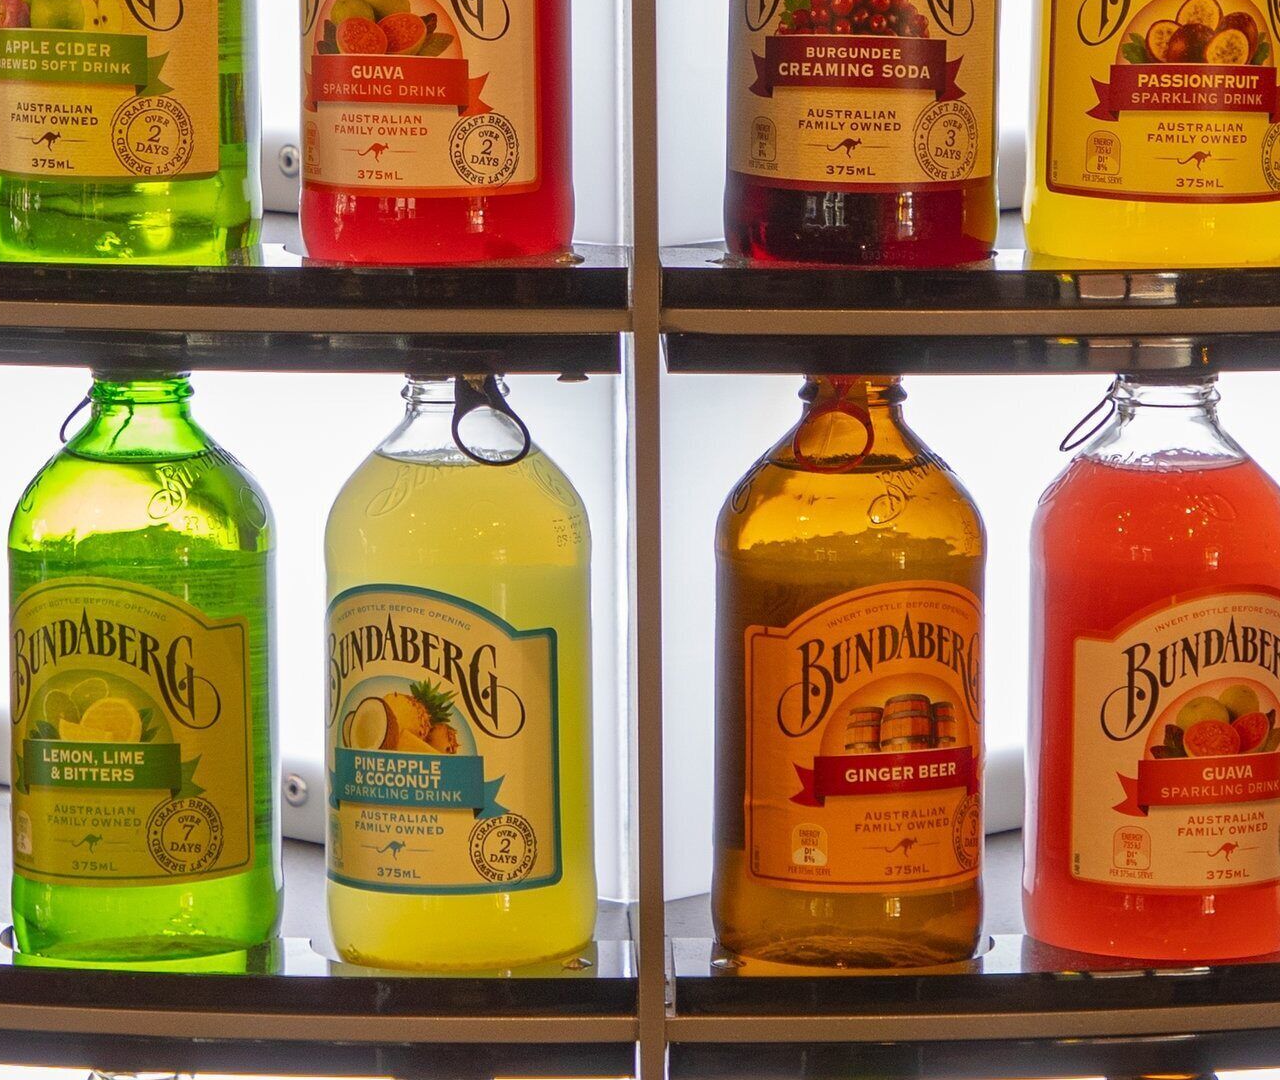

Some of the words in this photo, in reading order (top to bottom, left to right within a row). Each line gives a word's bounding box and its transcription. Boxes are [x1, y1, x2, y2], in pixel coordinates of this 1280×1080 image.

[5, 40, 50, 54] APPLE
[55, 41, 111, 57] CIDER
[806, 47, 901, 59] BURGUNDEE
[41, 60, 77, 72] SOFT
[83, 61, 130, 74] DRINK
[352, 66, 404, 79] GUAVA
[779, 63, 873, 77] CREAMING
[882, 65, 930, 78] SODA
[1138, 74, 1259, 88] PASSIONFRUIT
[323, 84, 392, 96] SPARKLING
[399, 85, 446, 97] DRINK
[1131, 93, 1218, 104] SPARKLING
[1224, 94, 1262, 105] DRINK
[17, 102, 92, 114] AUSTRALIAN
[807, 109, 896, 119] AUSTRALIAN
[11, 113, 46, 124] FAMILY
[50, 115, 98, 126] OWNED
[341, 114, 422, 124] AUSTRALIAN
[798, 121, 845, 130] FAMILY
[850, 121, 901, 131] OWNED
[334, 125, 373, 135] FAMILY
[378, 126, 428, 136] OWNED
[12, 607, 220, 729] BUNDABERG
[43, 749, 98, 766] LEMON,
[103, 752, 144, 765] LIME
[355, 756, 441, 775] PINEAPPLE
[845, 767, 914, 782] GINGER
[919, 763, 956, 778] BEER
[1202, 765, 1253, 779] GUAVA
[50, 767, 61, 780] &
[64, 768, 134, 781] BITTERS
[355, 774, 364, 784] &
[366, 774, 441, 788] COCONUT
[345, 785, 409, 800] SPARKLING
[415, 790, 461, 802] DRINK
[1161, 783, 1243, 798] SPARKLING
[1248, 780, 1279, 793] DRINK
[865, 807, 946, 820] AUSTRALIAN
[1188, 811, 1265, 825] AUSTRALIAN
[855, 821, 904, 833] FAMILY
[907, 817, 950, 831] OWNED
[1178, 825, 1225, 836] FAMILY
[1229, 822, 1268, 835] OWNED
[497, 830, 517, 840] OVER
[499, 838, 511, 853] 2
[490, 853, 517, 865] DAYS
